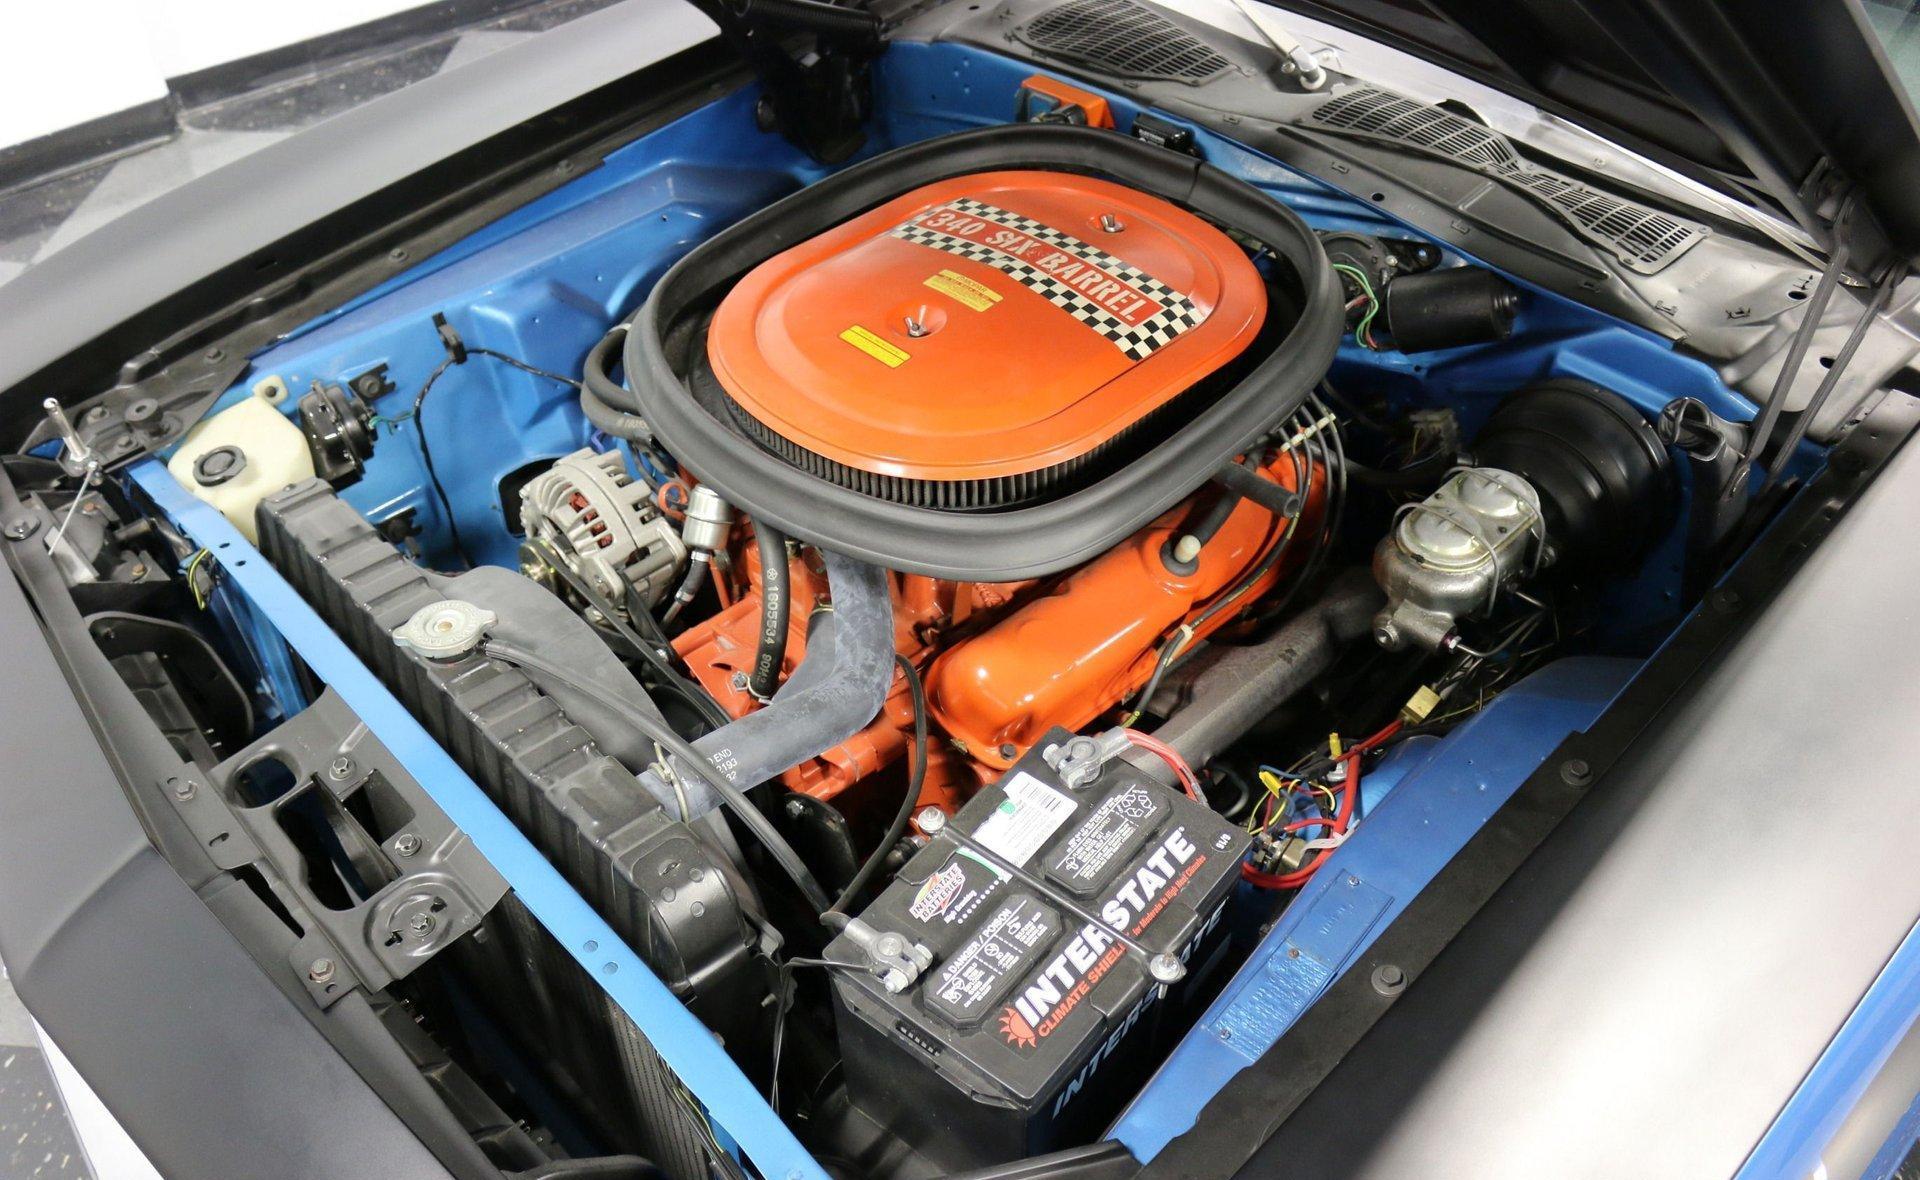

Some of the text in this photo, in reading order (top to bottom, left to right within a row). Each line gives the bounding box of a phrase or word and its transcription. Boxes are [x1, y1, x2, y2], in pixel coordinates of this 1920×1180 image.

[927, 213, 1147, 322] 340 SIX BARREL
[713, 748, 732, 763] END
[912, 865, 958, 915] INTERSTATE
[921, 874, 962, 919] BATTERIES
[947, 939, 980, 974] DANGER
[982, 906, 1012, 938] POISON
[1038, 980, 1091, 1037] CLIMATE
